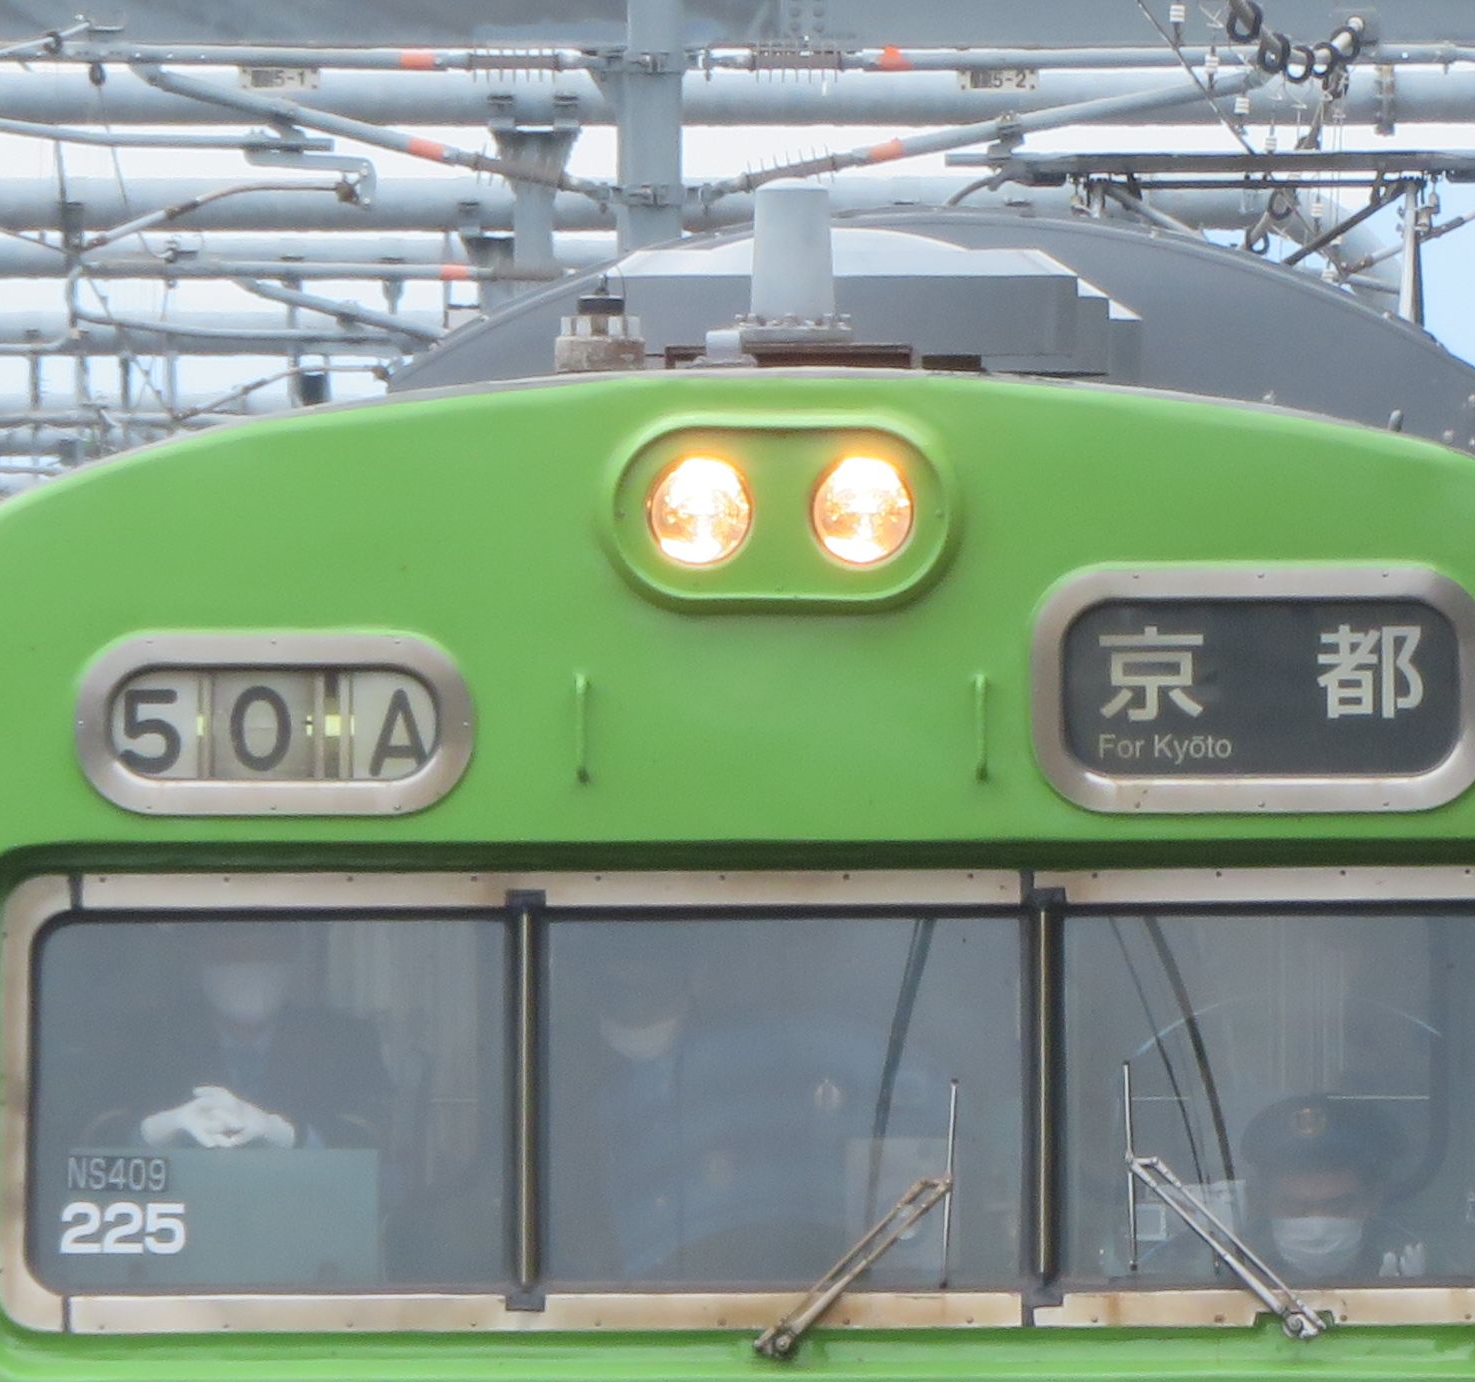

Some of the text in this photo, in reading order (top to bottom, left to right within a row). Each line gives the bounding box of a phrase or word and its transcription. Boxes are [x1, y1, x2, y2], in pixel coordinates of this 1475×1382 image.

[1099, 625, 1424, 722] 京都
[1099, 733, 1232, 765] For Kyōto
[67, 1157, 166, 1191] NS409
[60, 1202, 186, 1254] 225
